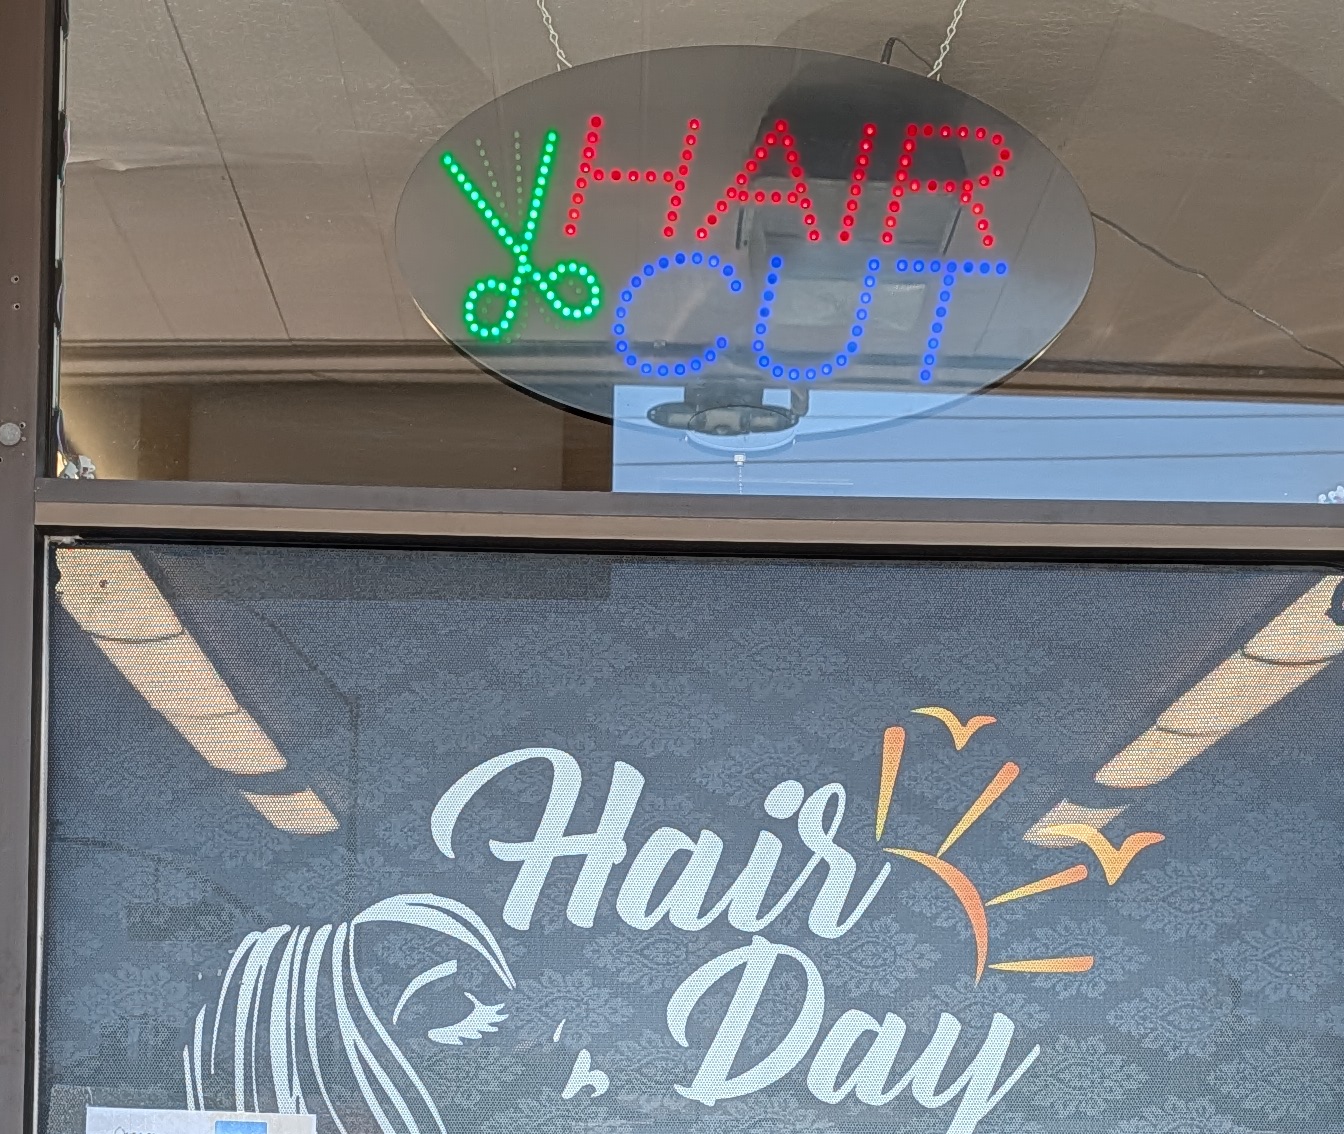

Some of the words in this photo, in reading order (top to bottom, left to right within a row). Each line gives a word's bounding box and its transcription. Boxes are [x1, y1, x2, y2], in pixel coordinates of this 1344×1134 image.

[564, 115, 1011, 248] HAIR
[613, 251, 1007, 382] CUT
[430, 746, 892, 940] Hair
